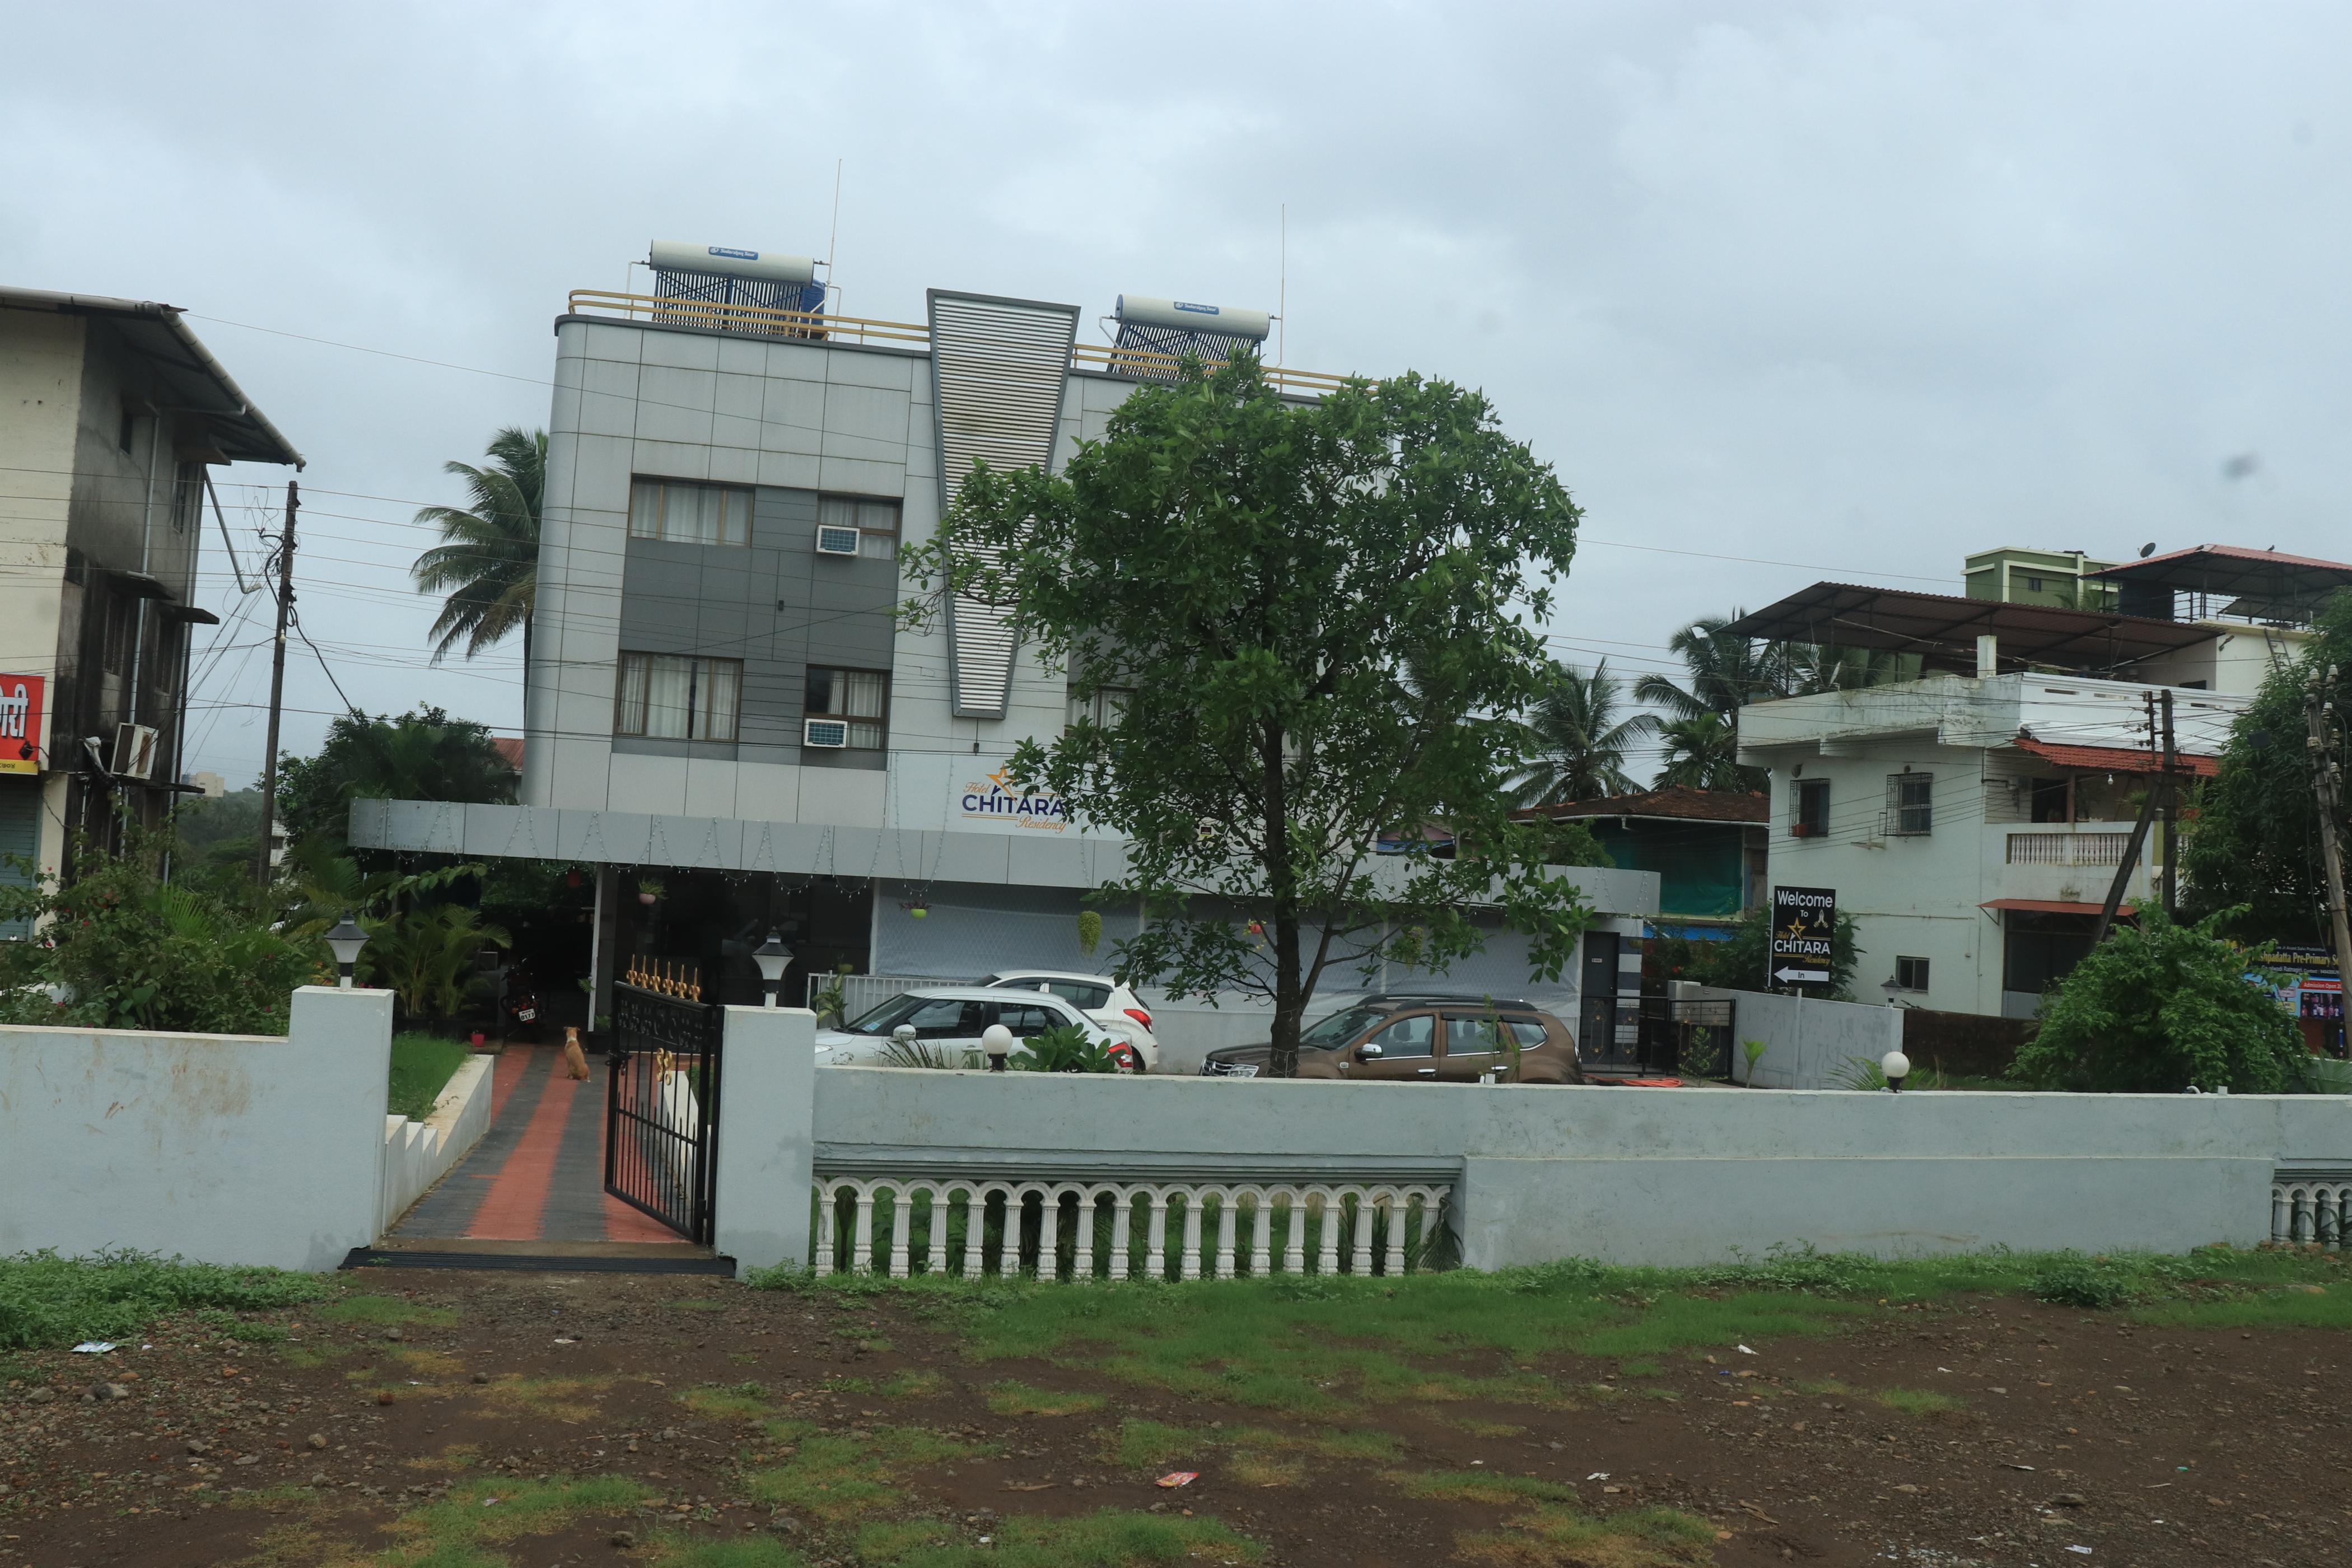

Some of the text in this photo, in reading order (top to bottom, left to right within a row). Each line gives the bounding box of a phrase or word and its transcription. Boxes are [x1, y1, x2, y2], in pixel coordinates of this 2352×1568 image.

[963, 782, 991, 794] Hotel
[962, 794, 1066, 816] CHITARA
[1015, 815, 1066, 834] Residency
[1777, 890, 1833, 908] Welcome
[1775, 931, 1790, 939] Hotel
[1774, 939, 1831, 954] CHITARA
[1803, 954, 1831, 966] Residency
[2252, 951, 2292, 964] shpadatta
[2293, 952, 2330, 967] Pre-Primary
